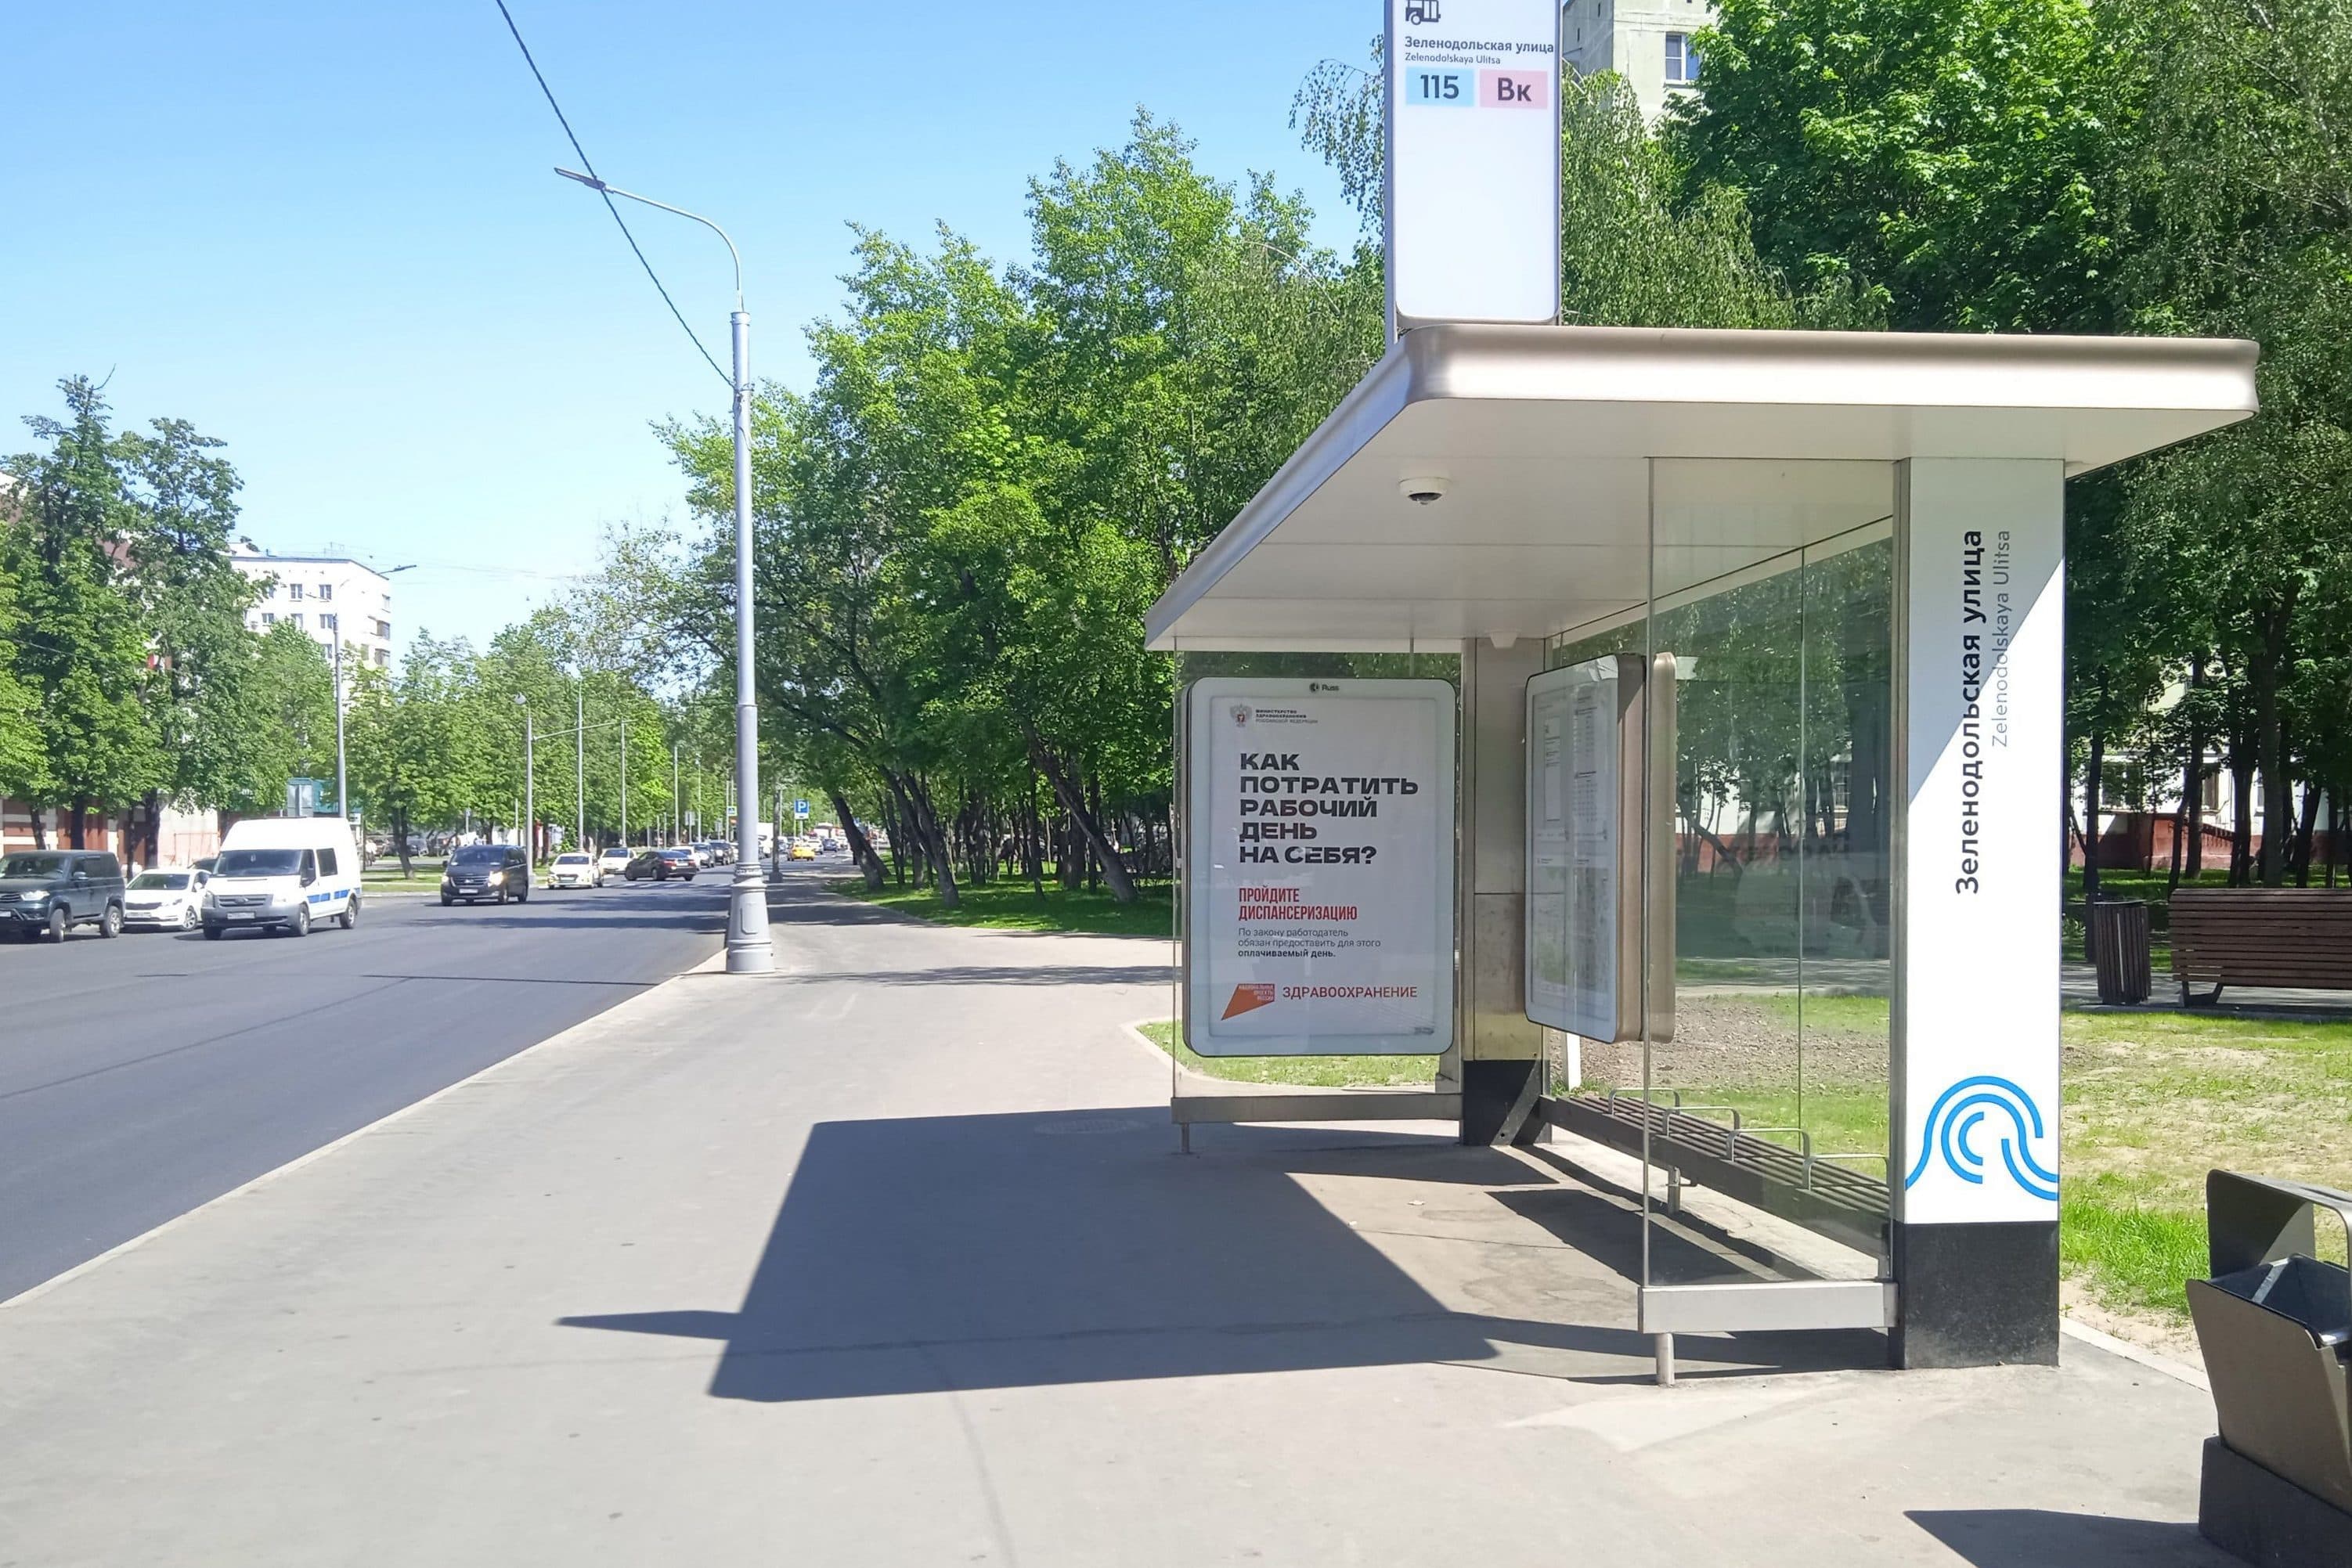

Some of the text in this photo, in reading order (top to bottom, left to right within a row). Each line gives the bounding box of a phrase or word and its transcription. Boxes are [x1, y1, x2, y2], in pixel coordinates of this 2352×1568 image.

[1405, 36, 1554, 54] Зеленодольская улица
[1405, 52, 1501, 66] Zelenodolskaya Ulitsa
[1420, 74, 1459, 99] 115
[1498, 77, 1532, 102] Вк
[1991, 530, 2011, 748] Zelenodolskaya Ulitsa
[1956, 530, 1986, 894] Зеленодольская улица
[1240, 753, 1300, 771] КАК
[1240, 776, 1419, 795] ПОТРАТИТЬ
[798, 801, 806, 812] P
[1240, 796, 1377, 817] РАБОЧИЙ
[1239, 822, 1317, 842] ДЕНЬ
[1239, 845, 1376, 864] НА СЕБЯ?
[1239, 885, 1300, 903] ПРОЙДИТЕ
[1239, 906, 1358, 921] ДИСПАНСЕРИЗАЦИЮ
[1239, 928, 1251, 936] По
[1286, 928, 1348, 938] работодатель
[1238, 949, 1336, 959] оплачиваемый день.
[1283, 986, 1417, 999] ЗДРАВООХРАНЕНИЕ
